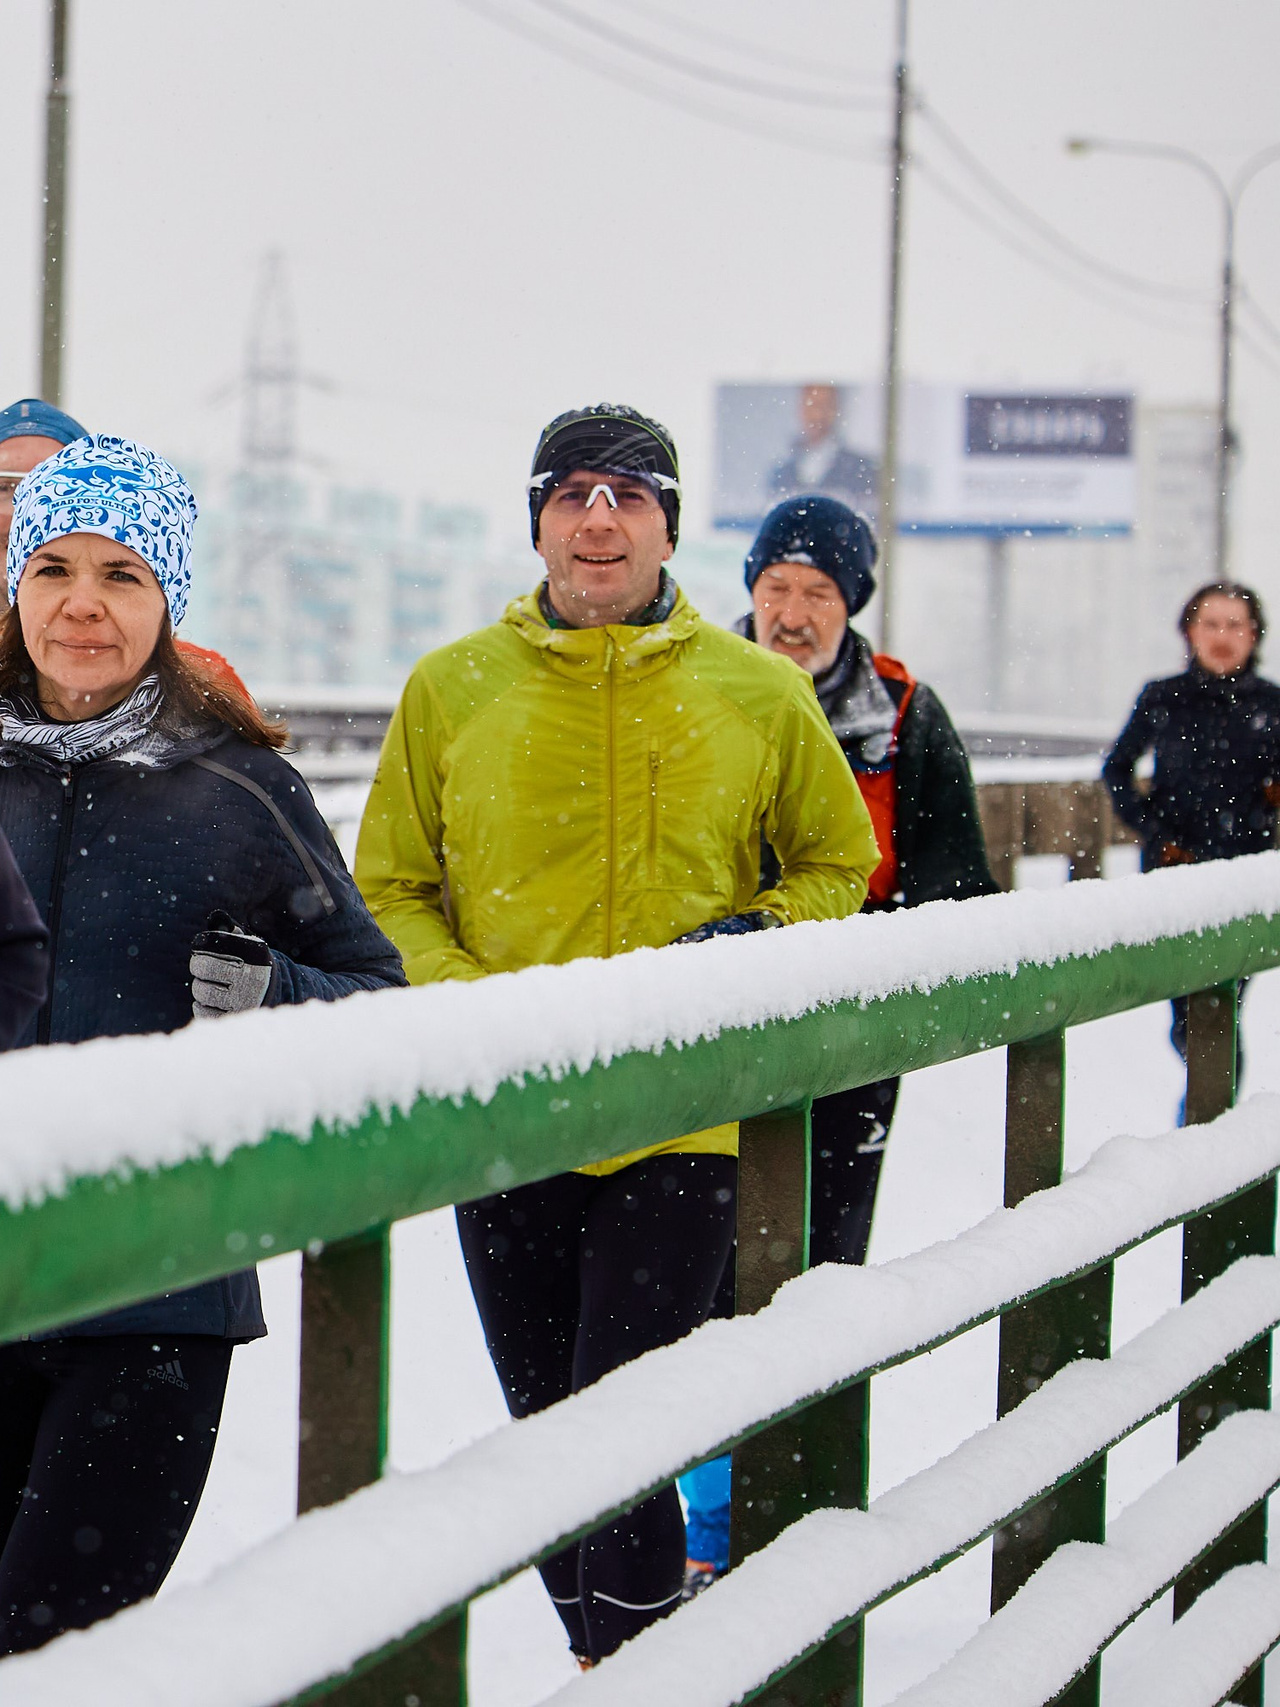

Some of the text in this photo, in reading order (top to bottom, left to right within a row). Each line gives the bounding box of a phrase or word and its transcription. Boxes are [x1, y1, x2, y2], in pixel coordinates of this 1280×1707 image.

[51, 498, 74, 510] MAD
[101, 499, 135, 516] ULTRA
[146, 1368, 190, 1391] adidas
